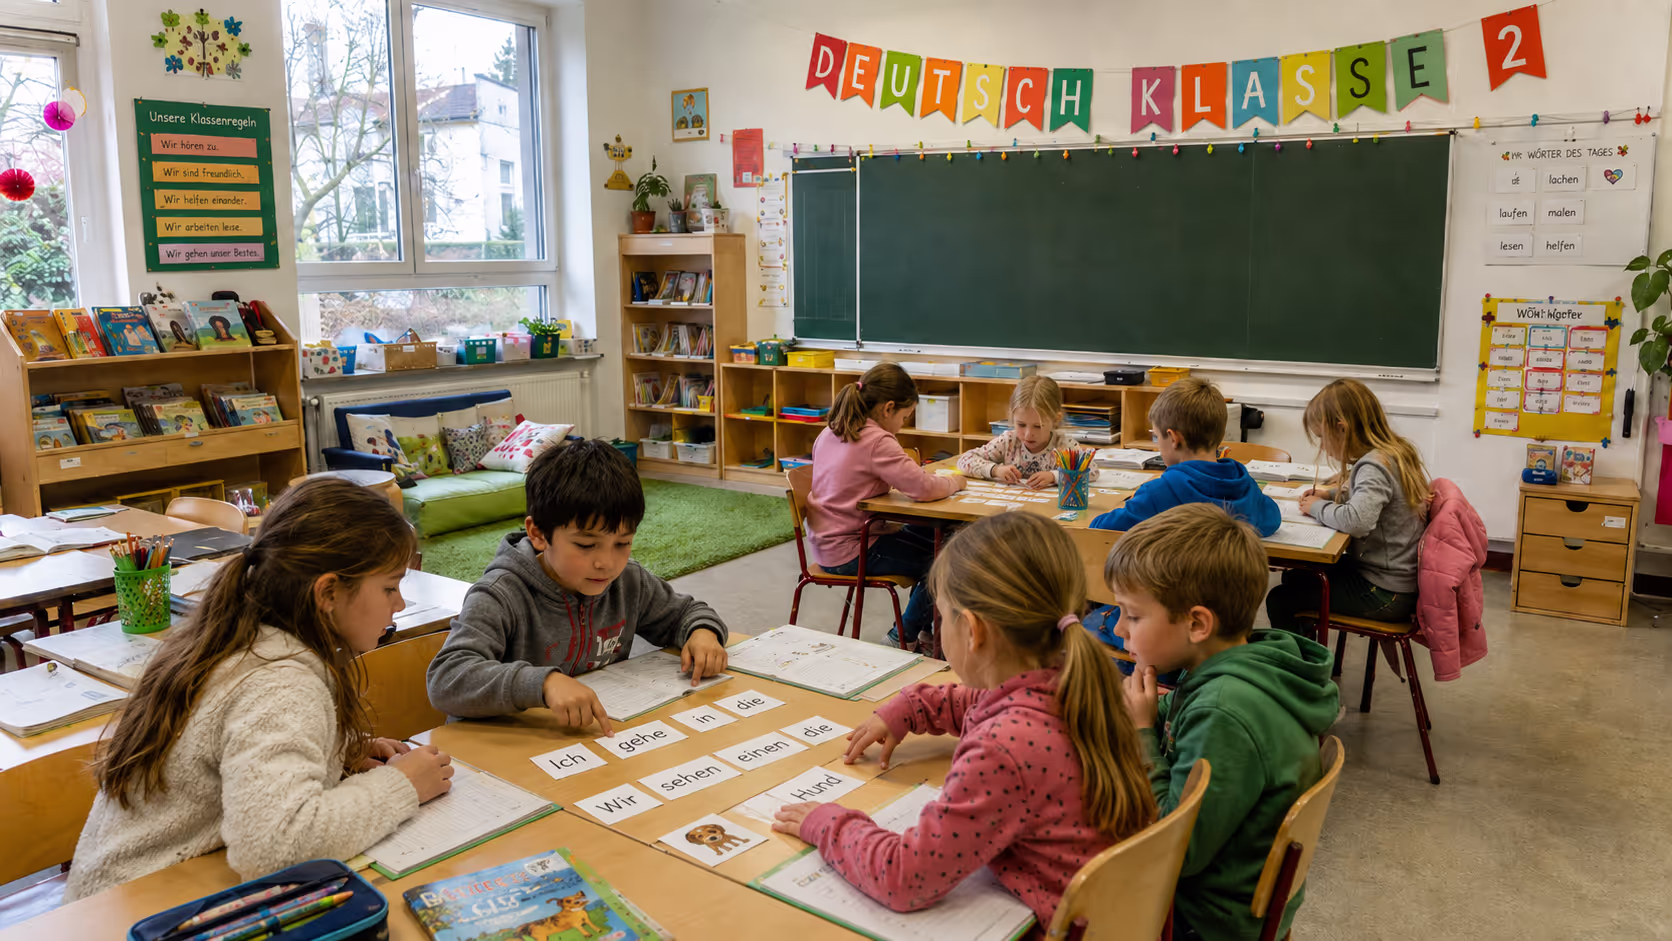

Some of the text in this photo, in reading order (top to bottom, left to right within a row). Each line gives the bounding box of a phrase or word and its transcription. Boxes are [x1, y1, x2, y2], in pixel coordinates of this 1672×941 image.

[815, 24, 1527, 116] DEUTSCH KLASSE 2
[149, 111, 257, 130] Unsere Klassenregeln
[160, 140, 178, 149] Wir
[207, 143, 219, 151] zu.
[1566, 149, 1582, 158] DES
[1587, 148, 1613, 157] TAGES
[163, 168, 179, 177] Wir
[182, 168, 199, 177] sind
[1548, 174, 1579, 184] lachen
[164, 194, 181, 204] Wir
[183, 194, 209, 207] helfen
[1499, 208, 1528, 220] laufen
[1547, 207, 1576, 217] malen
[164, 222, 182, 231] Wir
[1500, 241, 1524, 250] lesen
[1546, 241, 1576, 252] helfen
[166, 249, 182, 259] Wir
[549, 695, 765, 771] Ich gehe in die
[595, 722, 833, 815] Wir sehen einen die
[790, 774, 843, 801] Hund
